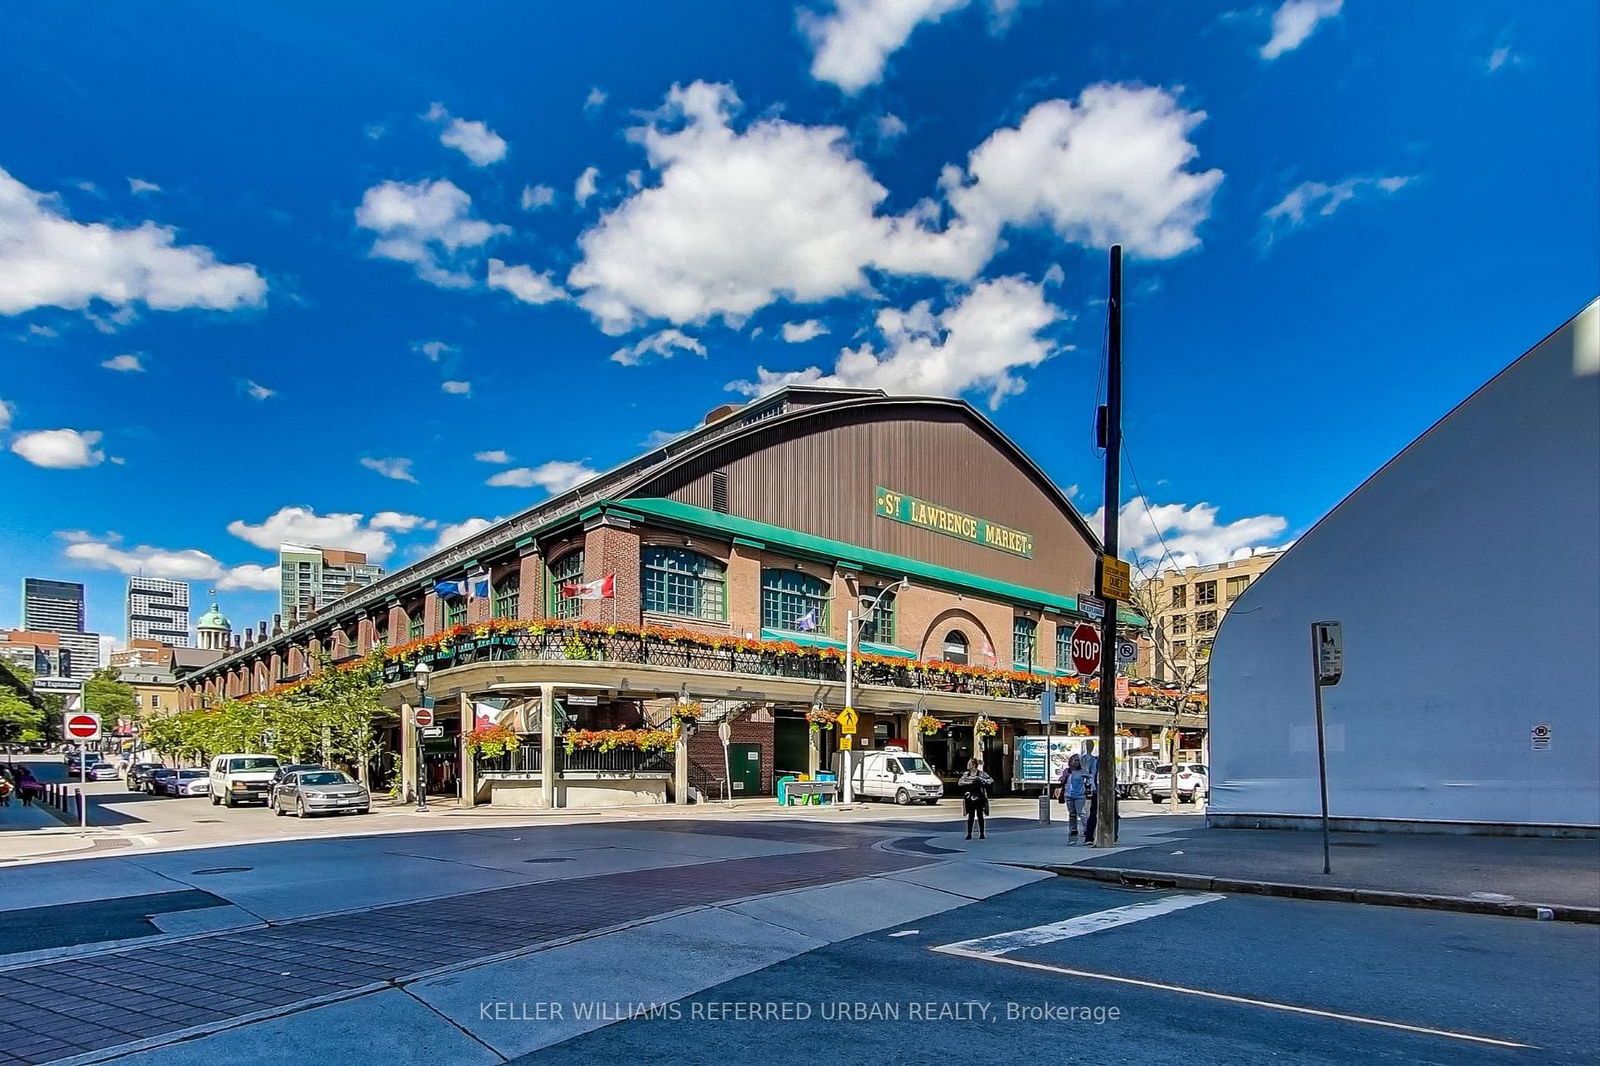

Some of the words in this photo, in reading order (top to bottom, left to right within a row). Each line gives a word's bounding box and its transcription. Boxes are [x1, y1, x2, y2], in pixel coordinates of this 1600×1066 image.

[911, 501, 978, 539] LAWRENCE
[985, 524, 1028, 554] MARKET
[1073, 638, 1099, 661] STOP
